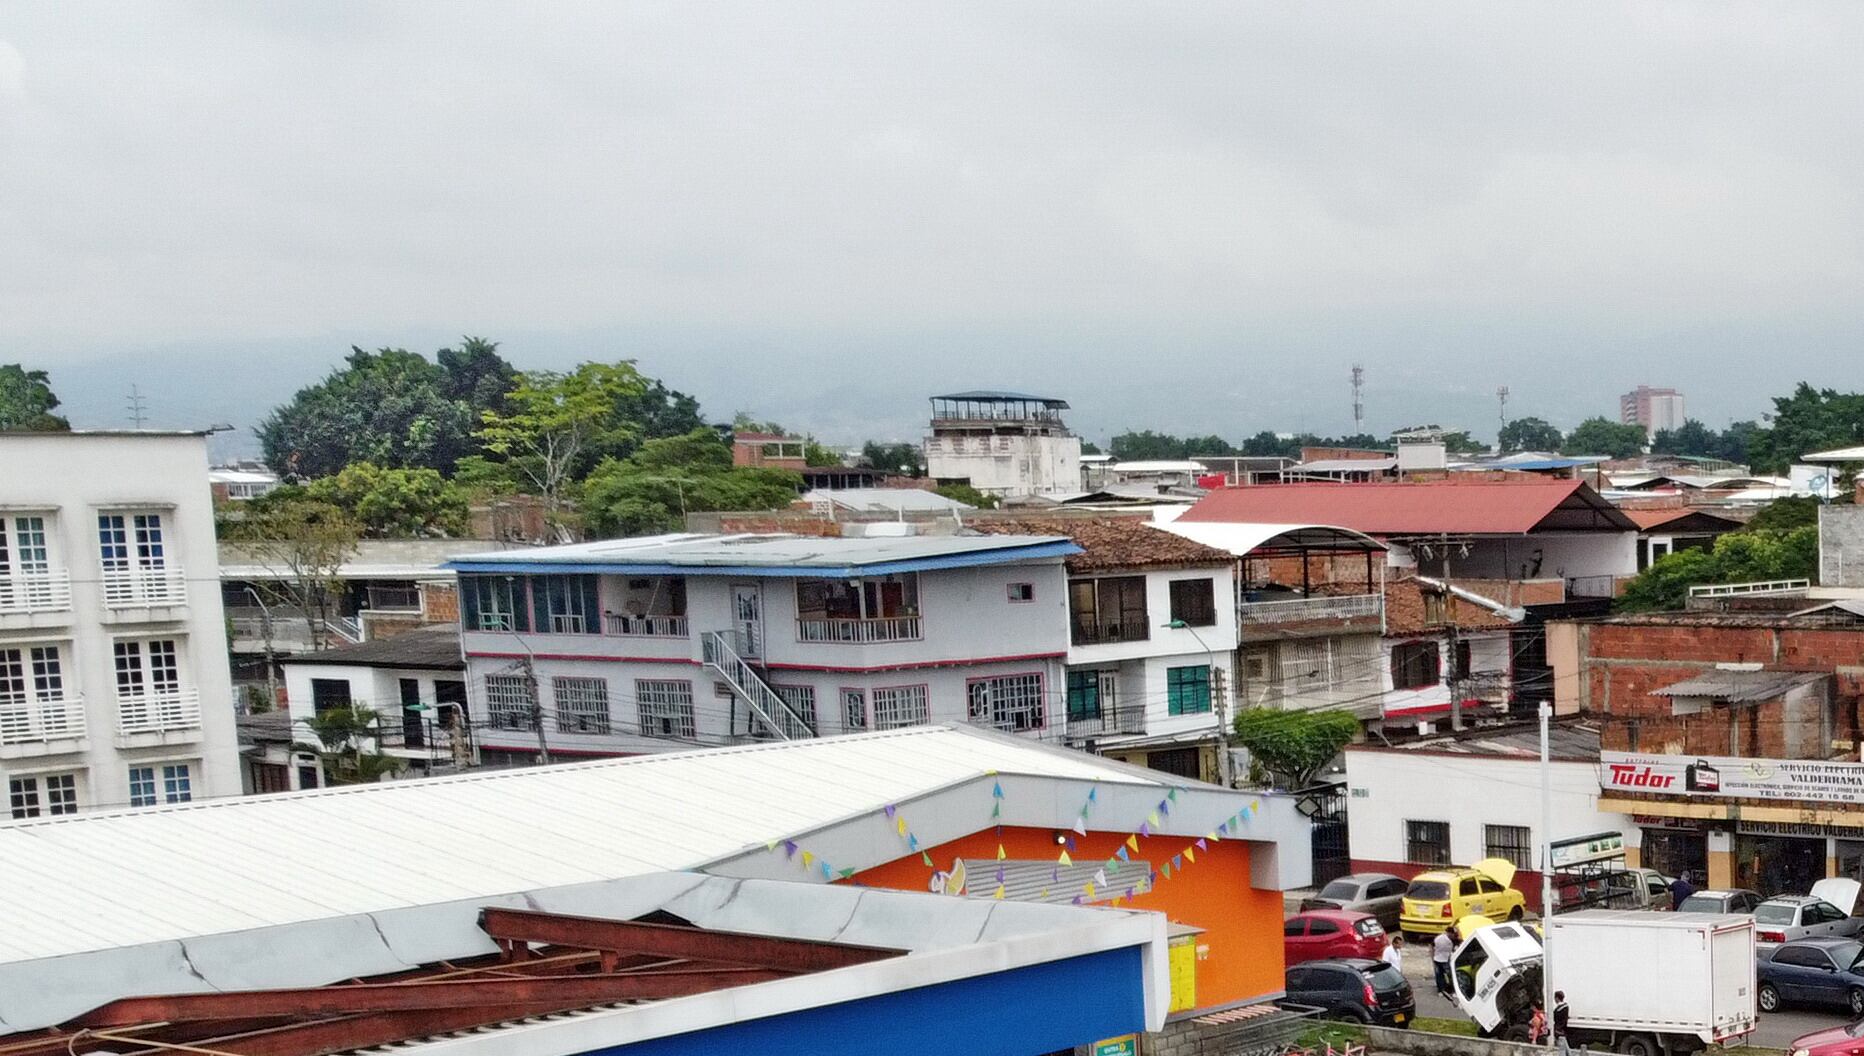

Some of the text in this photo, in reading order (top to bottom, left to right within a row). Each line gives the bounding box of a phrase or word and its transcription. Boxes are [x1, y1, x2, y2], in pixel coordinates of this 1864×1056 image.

[1779, 764, 1822, 773] SERVICIO
[1609, 764, 1676, 788] Tudor
[1790, 774, 1863, 786] VALDERRAMA
